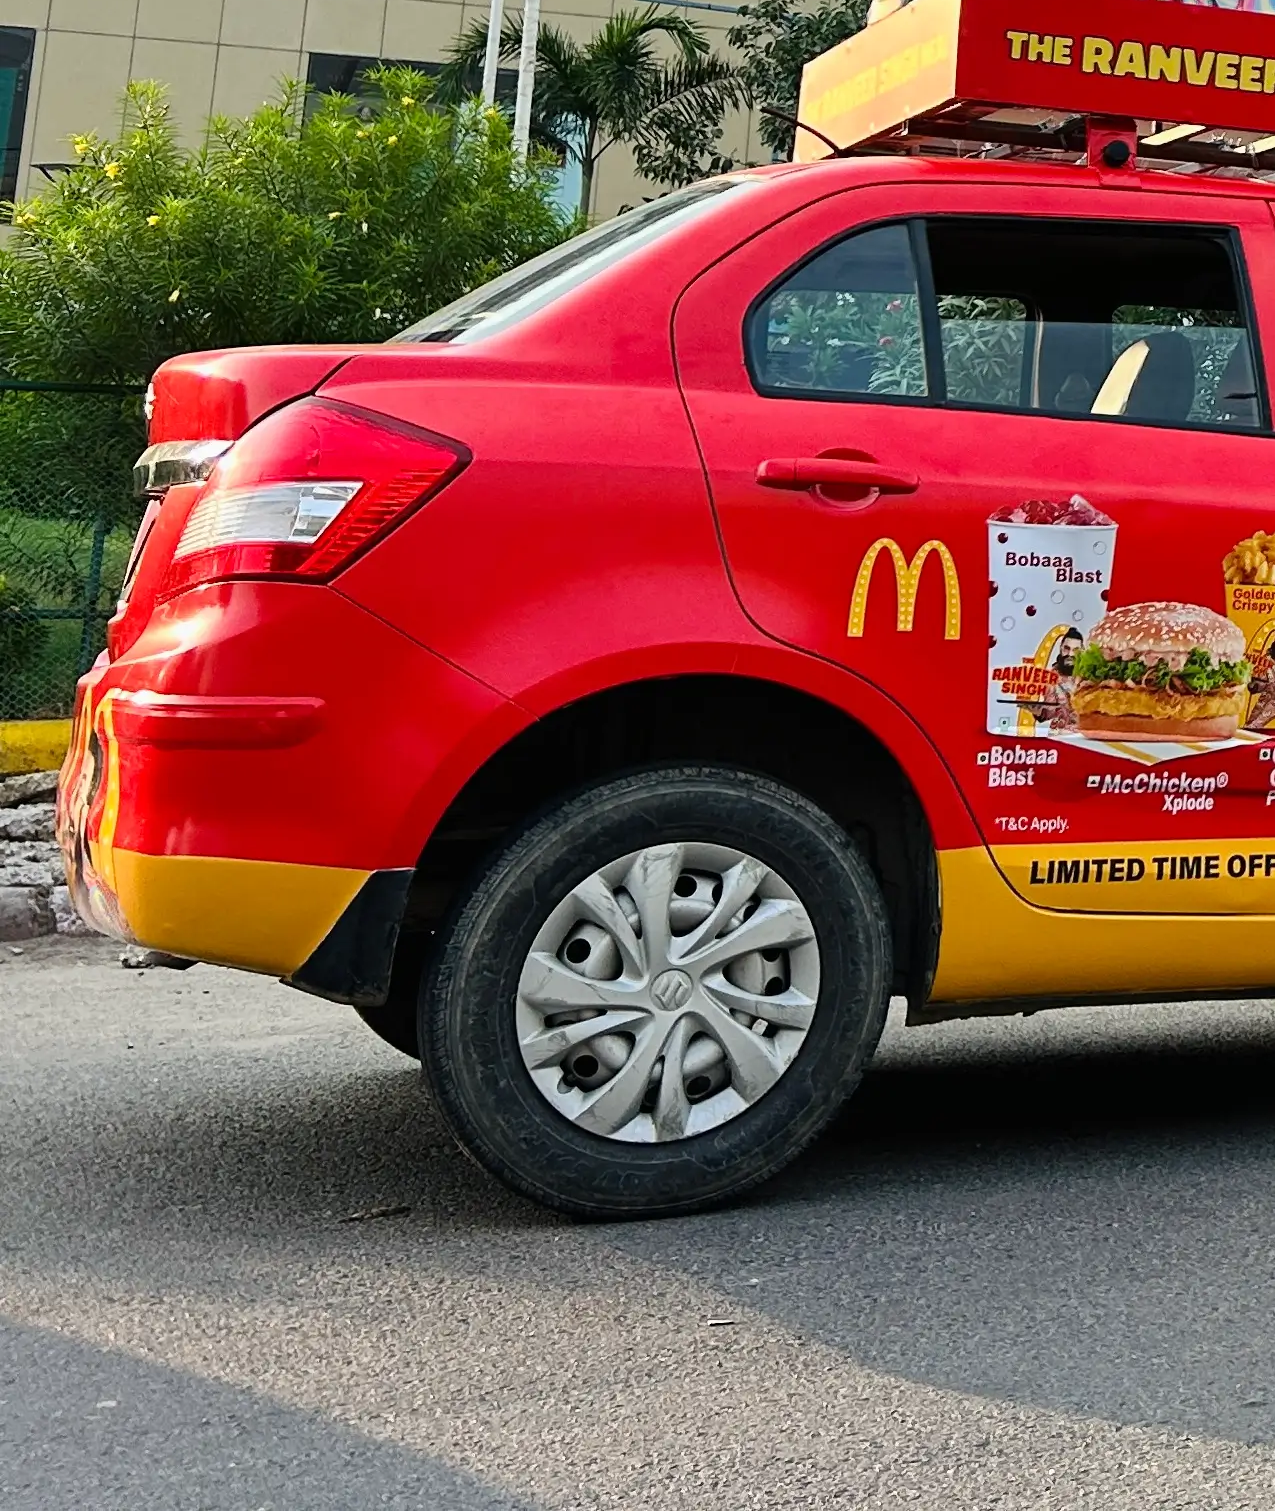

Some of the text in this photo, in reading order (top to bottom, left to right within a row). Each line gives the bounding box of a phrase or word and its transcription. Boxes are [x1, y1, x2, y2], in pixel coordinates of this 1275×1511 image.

[1005, 29, 1073, 66] THE
[1004, 551, 1074, 569] Bobaaa
[1055, 566, 1103, 584] Blast
[1231, 599, 1274, 614] Crispy
[988, 744, 1059, 766] Bobaaa
[987, 767, 1035, 787] Blast
[1161, 794, 1214, 815] Xplode
[1028, 856, 1146, 885] LIMITED
[1151, 855, 1221, 881] TIME
